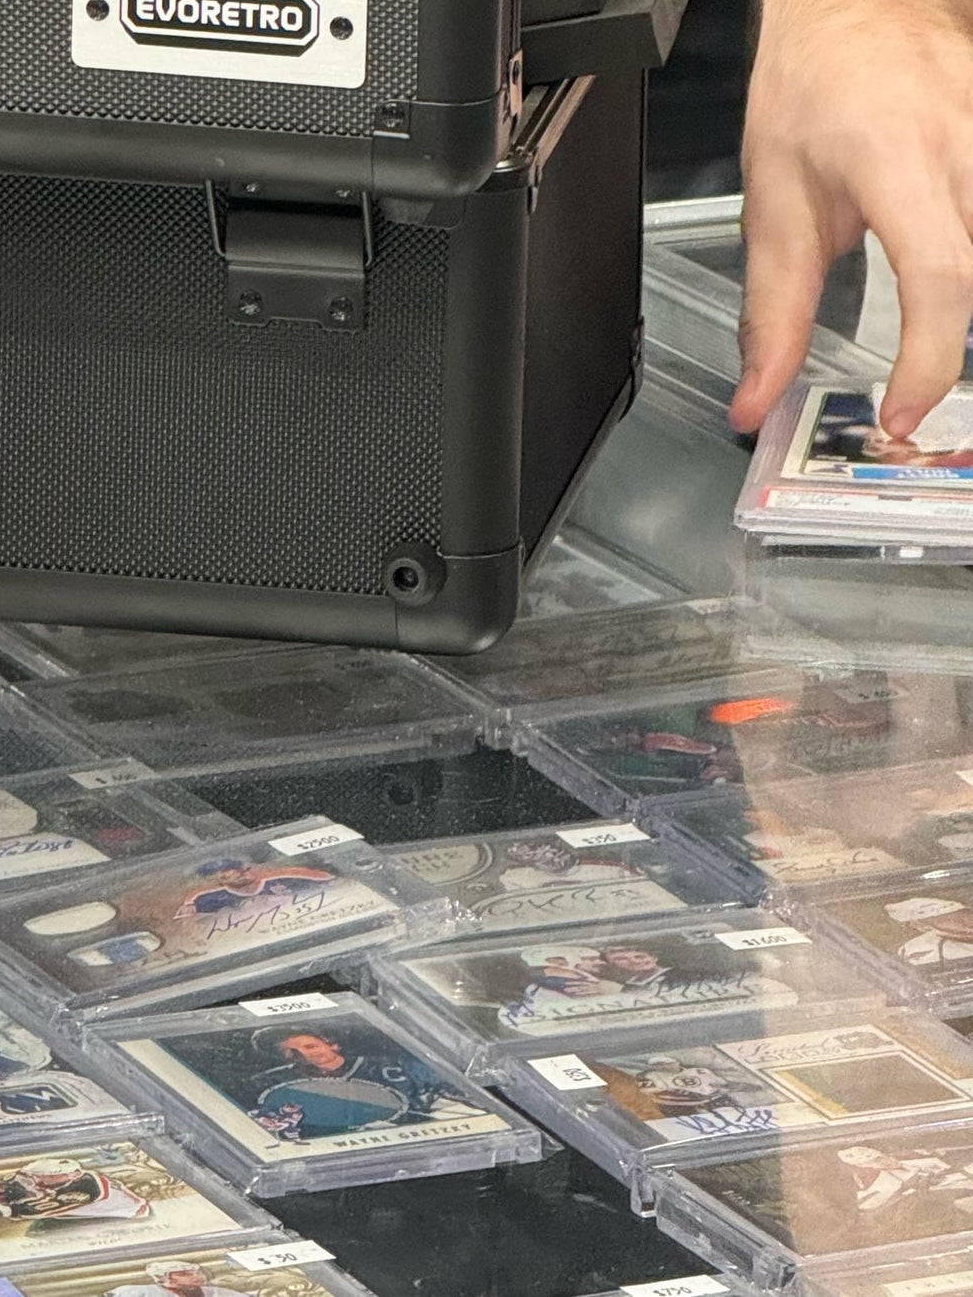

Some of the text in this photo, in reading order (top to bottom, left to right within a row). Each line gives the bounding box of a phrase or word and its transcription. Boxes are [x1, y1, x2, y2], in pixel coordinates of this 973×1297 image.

[297, 836, 340, 849] $2500
[266, 1001, 312, 1013] $3500
[332, 1123, 473, 1149] WAYNE GRETZKY
